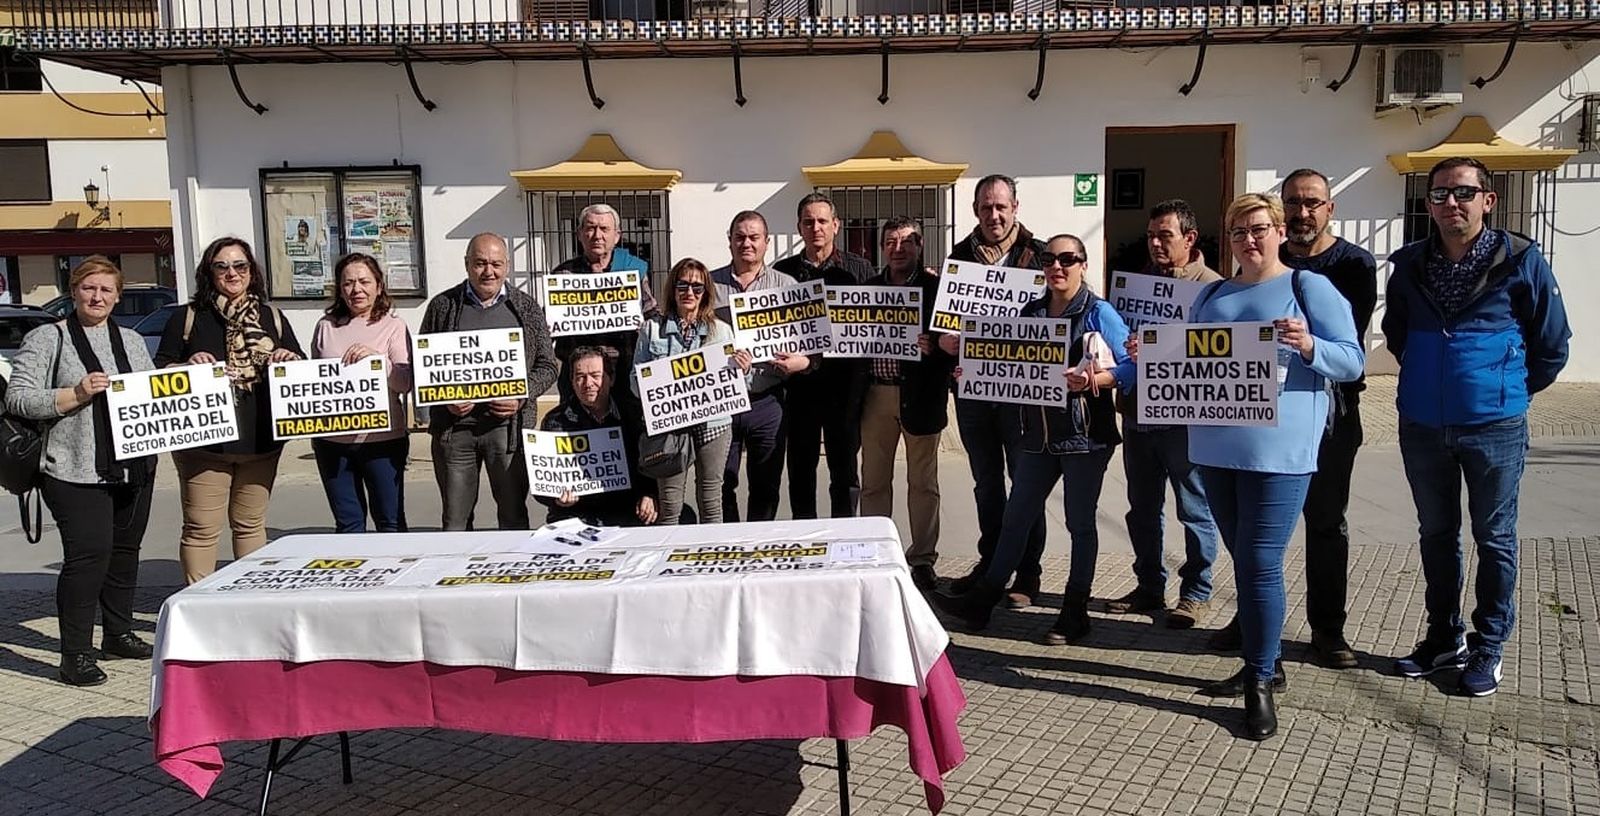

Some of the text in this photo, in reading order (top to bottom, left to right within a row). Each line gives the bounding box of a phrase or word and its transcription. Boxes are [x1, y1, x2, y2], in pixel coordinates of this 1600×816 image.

[562, 276, 623, 289] POR UNA
[985, 270, 1006, 284] EN
[550, 285, 637, 304] REGULACIÓN
[749, 288, 811, 309] POR UNA
[841, 292, 905, 305] POR UNA
[947, 281, 1038, 304] DEFENSA DE
[1153, 282, 1174, 298] EN
[563, 302, 628, 317] JUSTA DE
[738, 301, 825, 328] REGULACIÓN
[829, 305, 918, 324] REGULACIÓN
[948, 299, 1018, 318] NUESTRO
[1116, 297, 1184, 320] DEFENSA
[552, 315, 641, 333] ACTIVIDADES
[753, 320, 817, 342] JUSTA DE
[840, 325, 907, 339] JUSTA DE
[981, 322, 1050, 340] POR UNA
[459, 335, 480, 348] EN
[1188, 329, 1230, 356] NO
[423, 349, 518, 368] DEFENSA DE
[965, 342, 1064, 362] REGULACIÓN
[318, 363, 339, 377] EN
[429, 366, 514, 383] NUESTROS
[672, 354, 704, 379] NO
[977, 362, 1050, 380] JUSTA DE
[1145, 361, 1270, 379] ESTAMOS EN
[151, 373, 189, 398] NO
[280, 378, 380, 398] DEFENSA DE
[419, 381, 526, 402] TRABAJADORES
[647, 367, 738, 402] ESTAMOS EN
[963, 380, 1063, 402] ACTIVIDADES
[1147, 384, 1270, 402] CONTRA DEL
[118, 392, 227, 421] ESTAMOS EN
[287, 396, 376, 416] NUESTROS
[651, 384, 741, 417] CONTRA DEL
[651, 398, 747, 430] SECTOR ASOCIATIVO
[1145, 406, 1274, 420] SECTOR ASOCIATIVO
[122, 410, 229, 439] CONTRA DEL
[277, 412, 388, 435] TRABAJADORES
[122, 426, 235, 454] SECTOR ASOCIATIVO
[556, 436, 588, 454] NO
[531, 449, 622, 468] ESTAMOS EN
[535, 464, 623, 483] CONTRA DEL
[571, 477, 628, 493] ASOCIATIVO
[243, 567, 402, 577] ESTAMOS EN
[306, 559, 363, 569] NO
[466, 557, 616, 569] DEFENSA DE
[466, 565, 602, 576] NUESTROS
[659, 562, 824, 575] ACTIVIDADES
[685, 558, 764, 567] JUSTA
[216, 584, 282, 592] SECTOR
[232, 575, 334, 585] CONTRA
